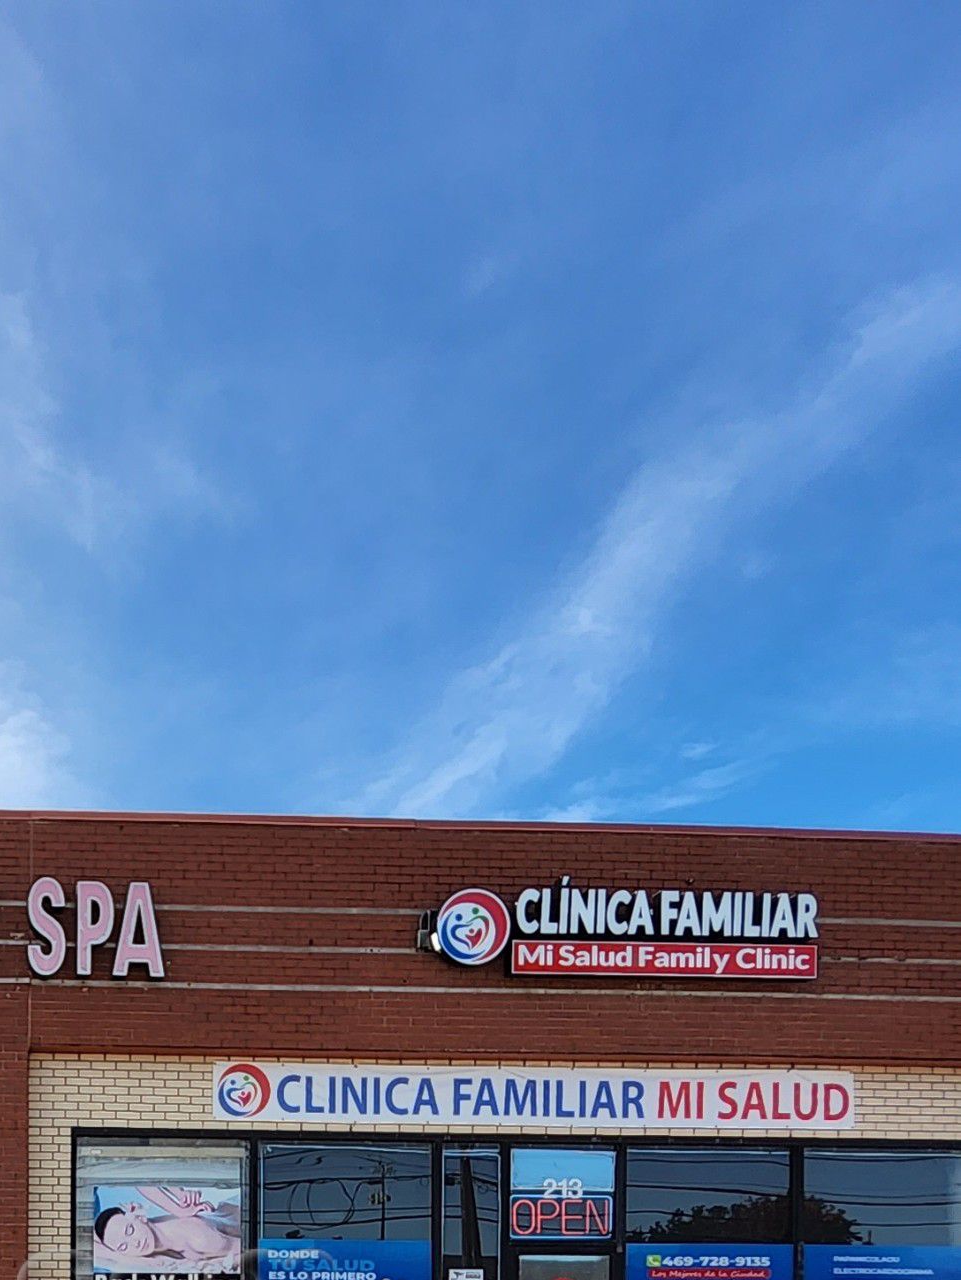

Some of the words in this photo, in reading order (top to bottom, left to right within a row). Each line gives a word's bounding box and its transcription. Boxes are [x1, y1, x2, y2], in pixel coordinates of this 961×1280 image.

[516, 876, 654, 936] CLÍNICA
[660, 890, 819, 938] FAMILIAR
[27, 877, 165, 977] SPA
[518, 944, 553, 967] Mi
[558, 945, 632, 968] Salud
[638, 947, 729, 975] Family
[735, 947, 811, 971] Clinic
[277, 1074, 439, 1115] CLINICA
[452, 1077, 645, 1118] FAMILIAR
[657, 1081, 704, 1119] MI
[717, 1081, 850, 1121] SALUD
[543, 1178, 583, 1199] 213
[512, 1199, 608, 1235] OPEN
[267, 1249, 319, 1259] DONDE
[269, 1260, 297, 1271] TU
[303, 1260, 375, 1271] SALUD
[662, 1256, 771, 1267] 469-728-9135
[269, 1271, 286, 1280] ES
[289, 1271, 308, 1280] LO
[312, 1272, 377, 1280] PRIMERO
